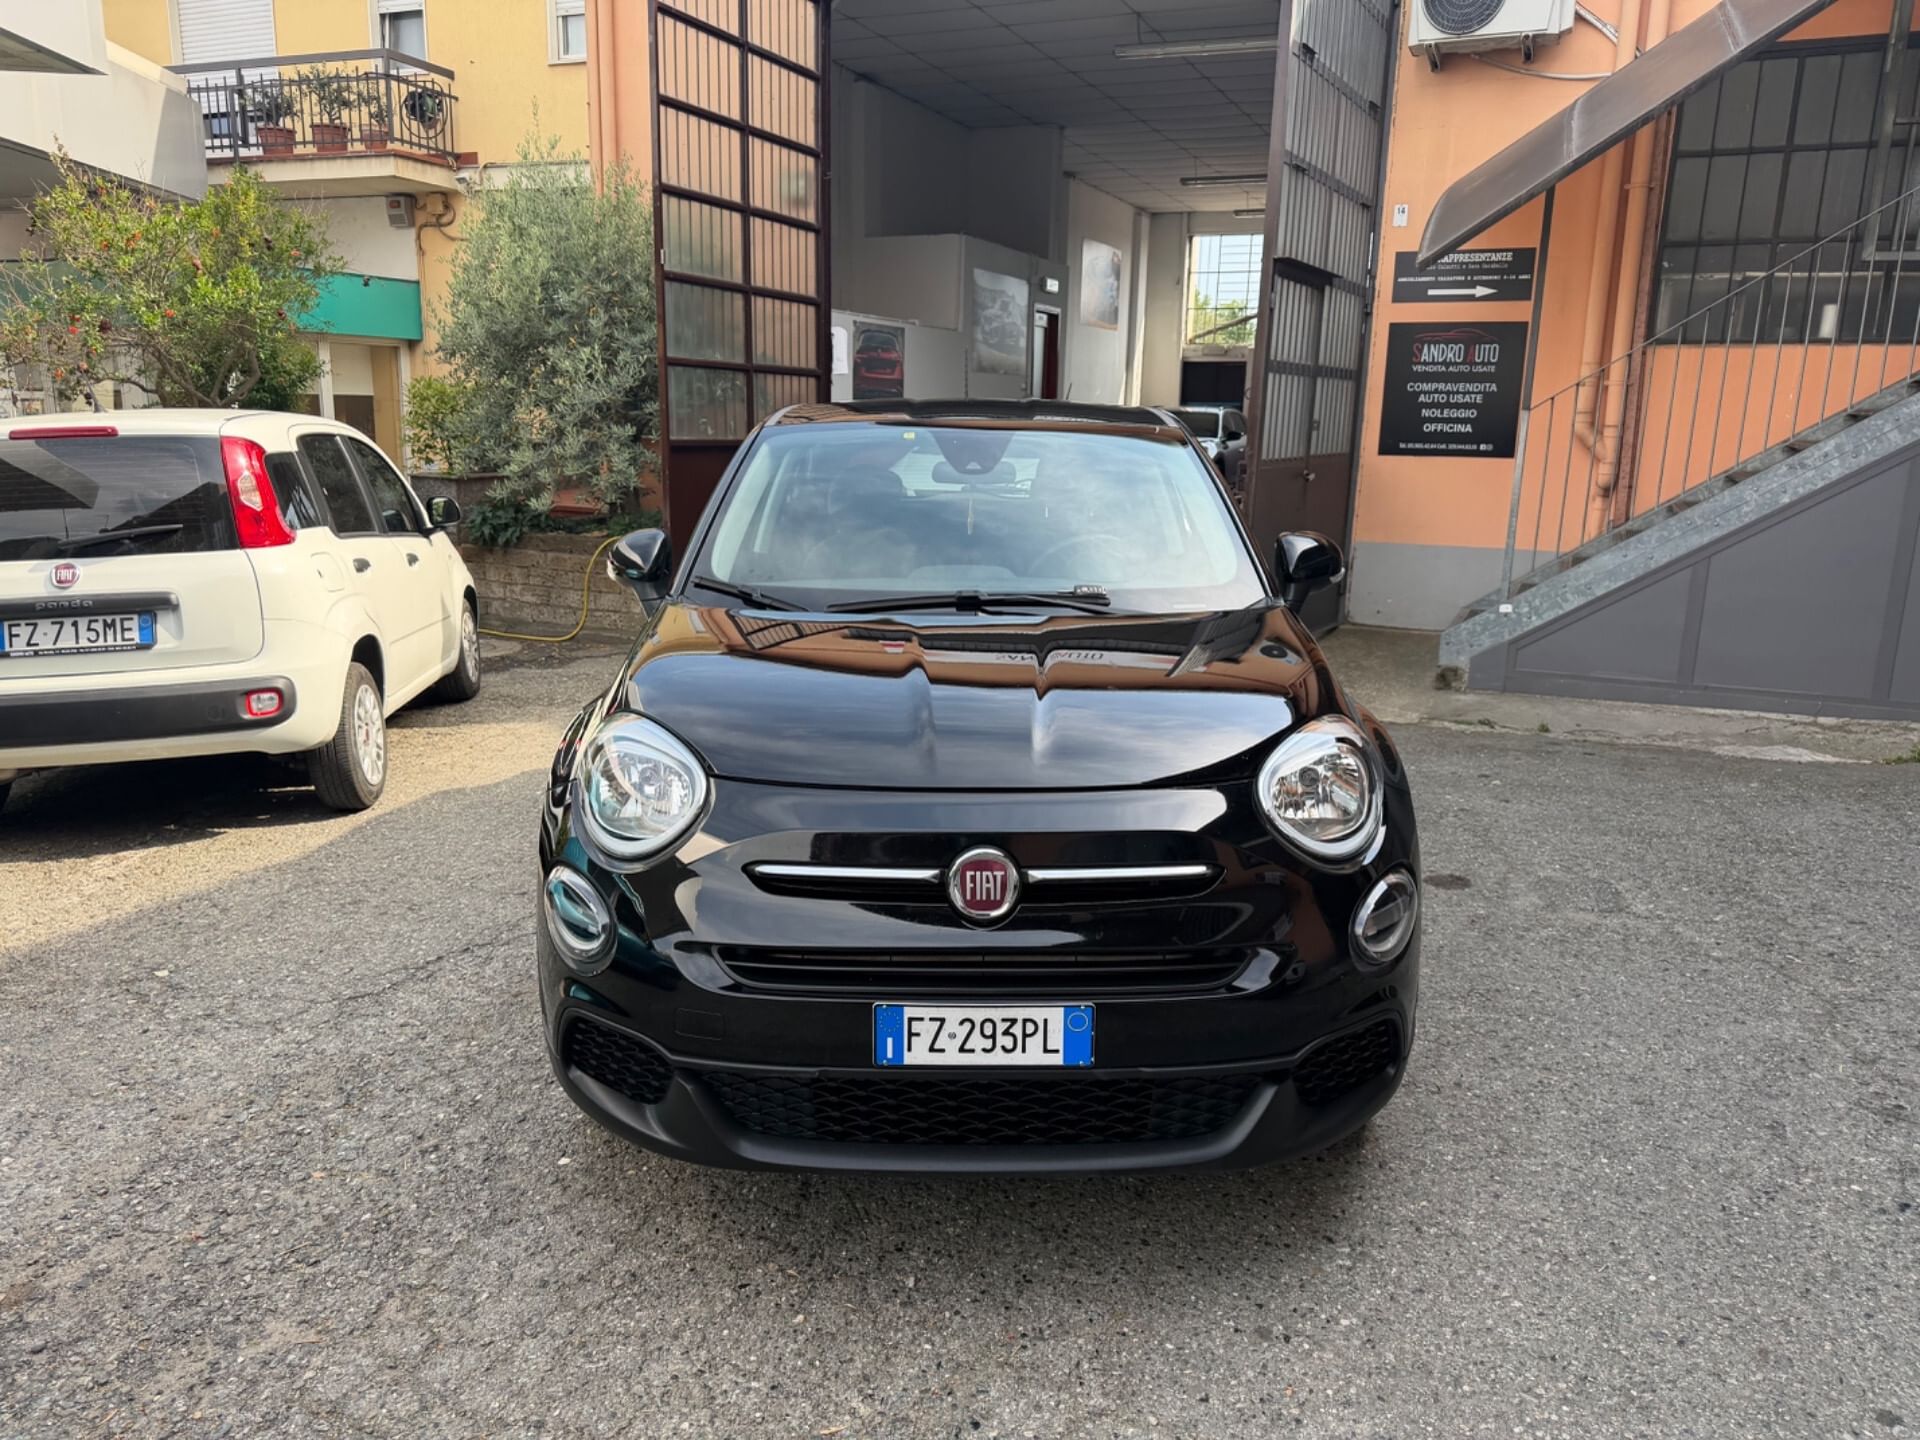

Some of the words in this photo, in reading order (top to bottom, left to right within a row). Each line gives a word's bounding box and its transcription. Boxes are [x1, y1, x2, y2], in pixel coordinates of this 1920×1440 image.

[1412, 343, 1465, 363] SANDRO
[1467, 343, 1500, 363] AUTO
[1471, 365, 1496, 373] USATE
[1407, 382, 1498, 392] COMPRAVENDITA
[1418, 393, 1447, 403] AUTO
[1449, 393, 1483, 403] USATE
[1421, 408, 1477, 418] NOLEGGIO
[1423, 423, 1472, 433] OFFICINA
[36, 600, 93, 610] panda
[51, 617, 135, 645] 715ME
[966, 871, 1005, 901] FIAT
[906, 1017, 946, 1053] FZ
[957, 1017, 1060, 1054] 293PL
